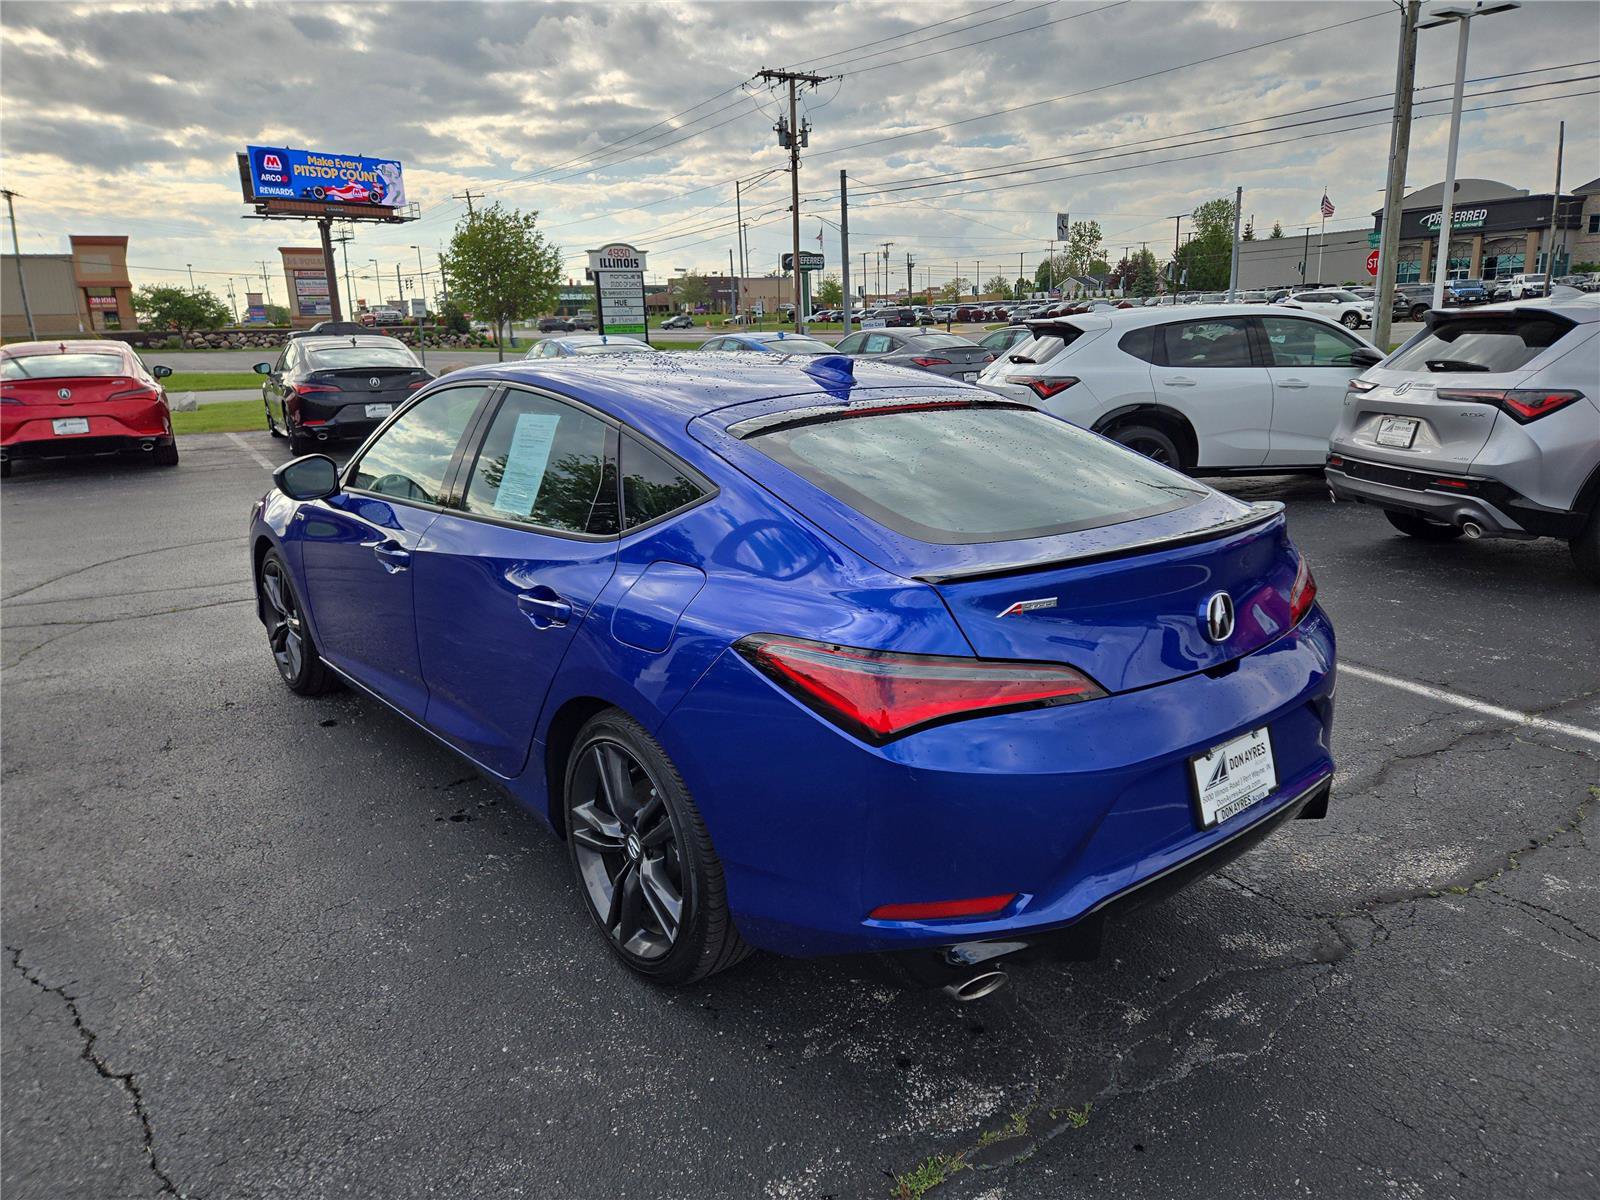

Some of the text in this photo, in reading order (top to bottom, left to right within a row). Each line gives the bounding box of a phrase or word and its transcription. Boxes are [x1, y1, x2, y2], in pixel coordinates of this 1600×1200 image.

[307, 155, 363, 171] Make Every
[260, 173, 282, 182] ARCO
[293, 164, 379, 183] PITSTOP COUNT
[259, 186, 294, 197] REWARDS
[1427, 209, 1488, 227] PRFERRED
[607, 248, 631, 258] 4930
[600, 258, 639, 269] ILLINOIS
[1367, 258, 1379, 269] ST
[614, 299, 628, 307] HUE
[1229, 754, 1244, 770] DON
[1244, 742, 1267, 761] AYRES
[1221, 807, 1234, 819] DON
[1234, 795, 1252, 812] AYRES
